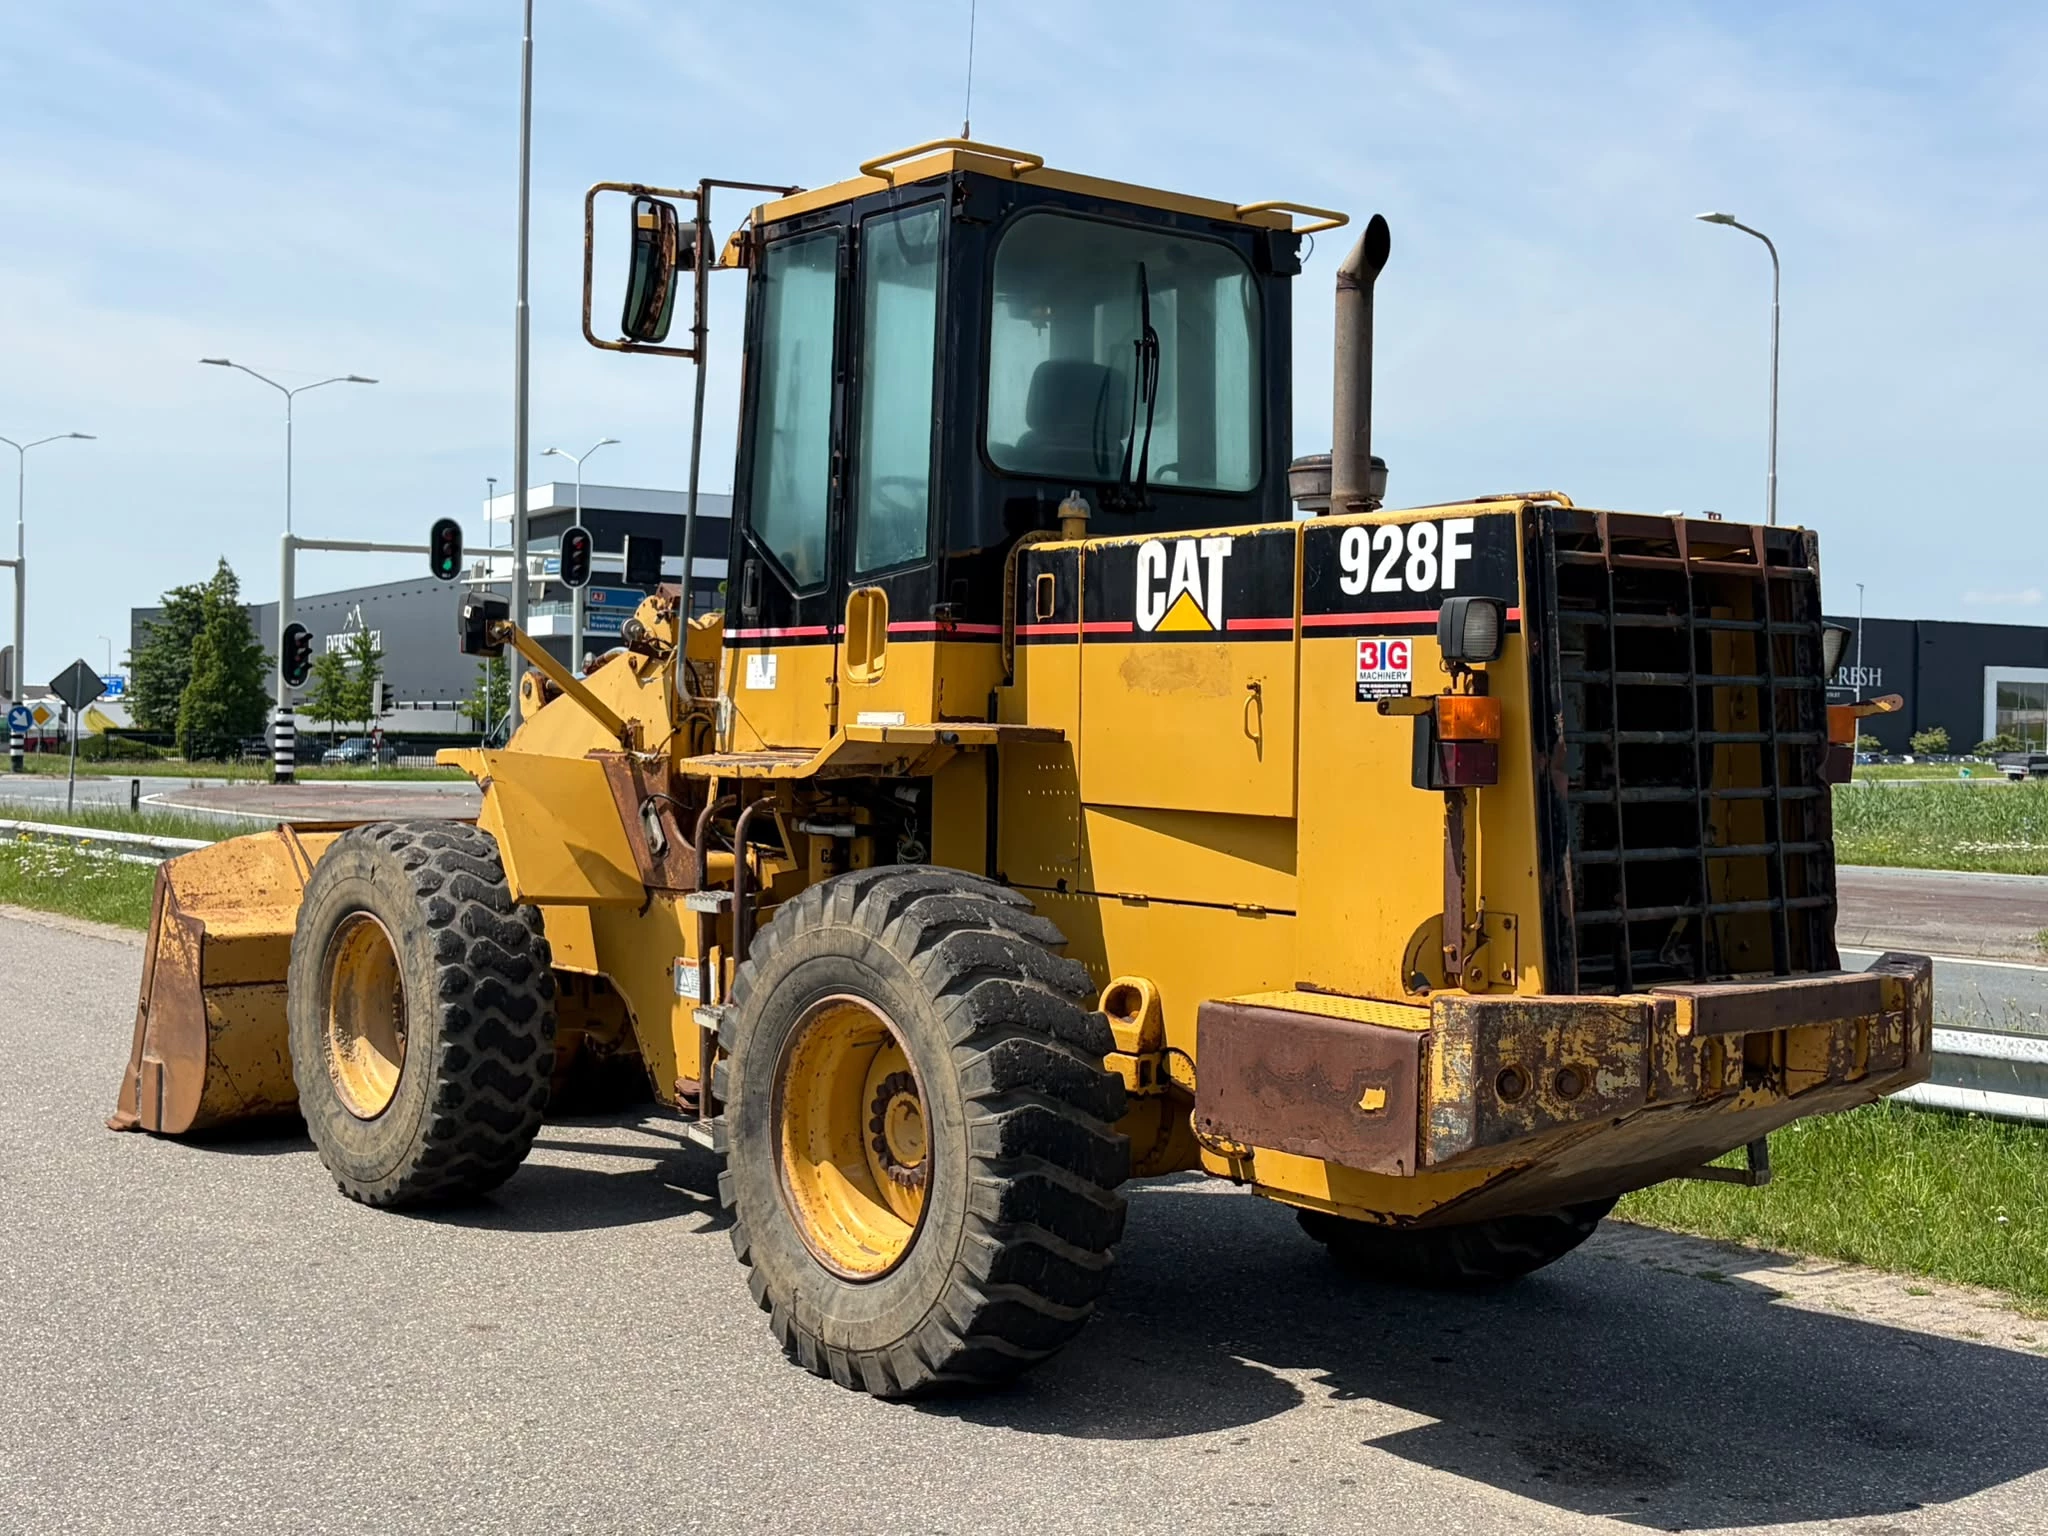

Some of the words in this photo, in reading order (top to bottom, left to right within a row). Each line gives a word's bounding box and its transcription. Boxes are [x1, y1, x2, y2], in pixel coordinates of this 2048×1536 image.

[1136, 536, 1233, 632] CAT
[1339, 518, 1475, 596] 928F
[1360, 671, 1408, 680] MACHINERY
